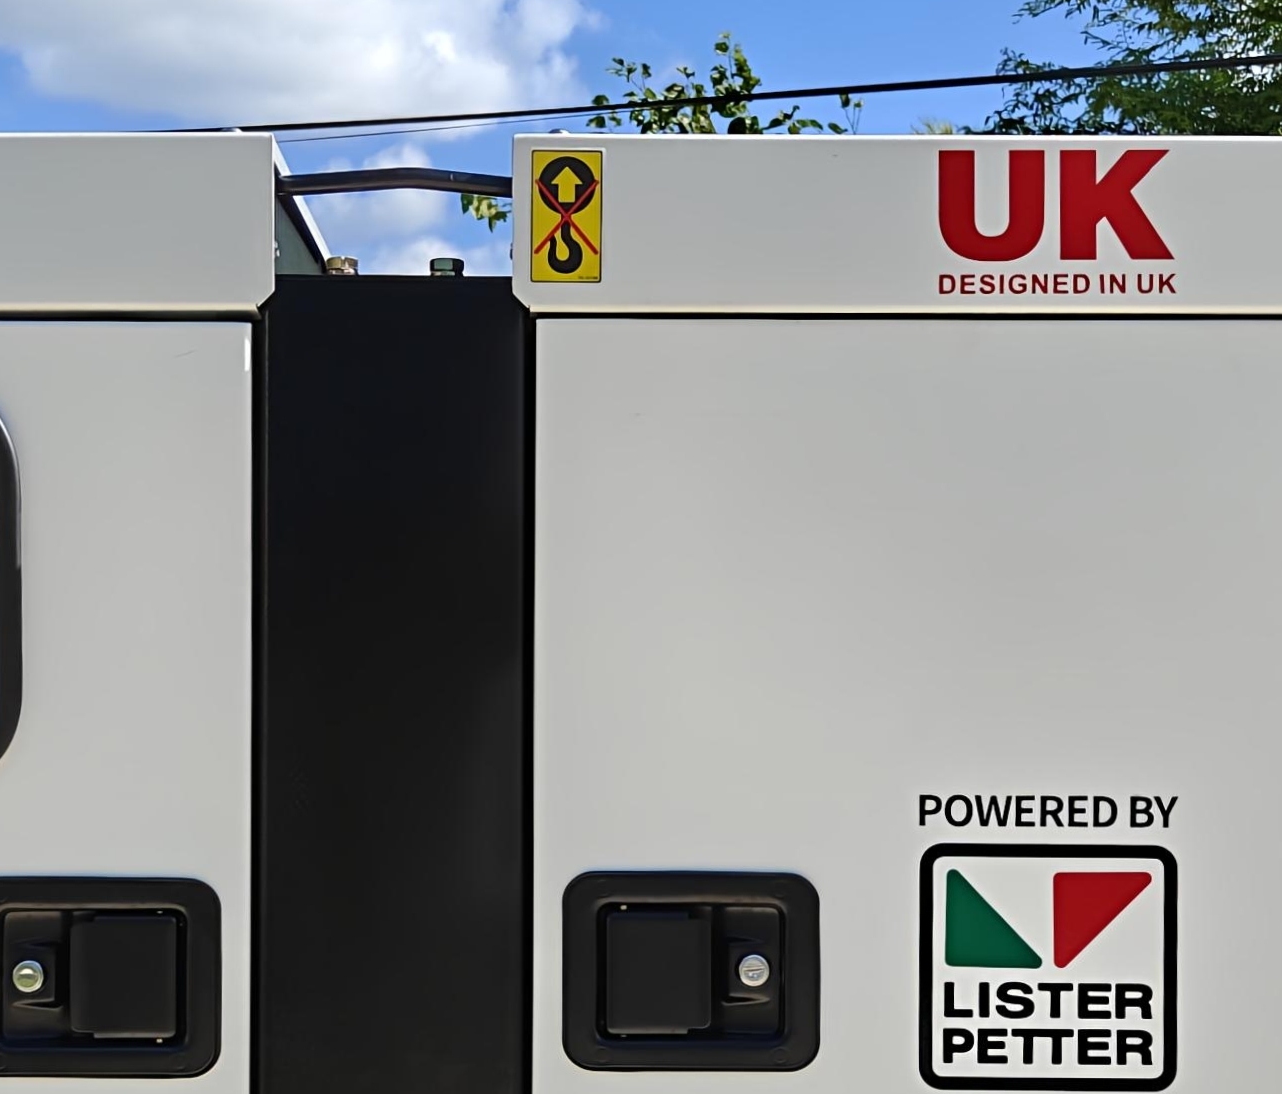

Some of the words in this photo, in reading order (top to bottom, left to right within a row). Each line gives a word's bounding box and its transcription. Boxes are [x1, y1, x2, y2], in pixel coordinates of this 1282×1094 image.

[938, 149, 1175, 262] UK
[938, 273, 1091, 295] DESIGNED
[1099, 274, 1127, 294] IN
[1137, 274, 1177, 295] UK
[918, 794, 1118, 828] POWERED
[1129, 796, 1179, 828] BY
[943, 981, 1154, 1020] LISTER
[942, 1028, 1154, 1066] PETTER
